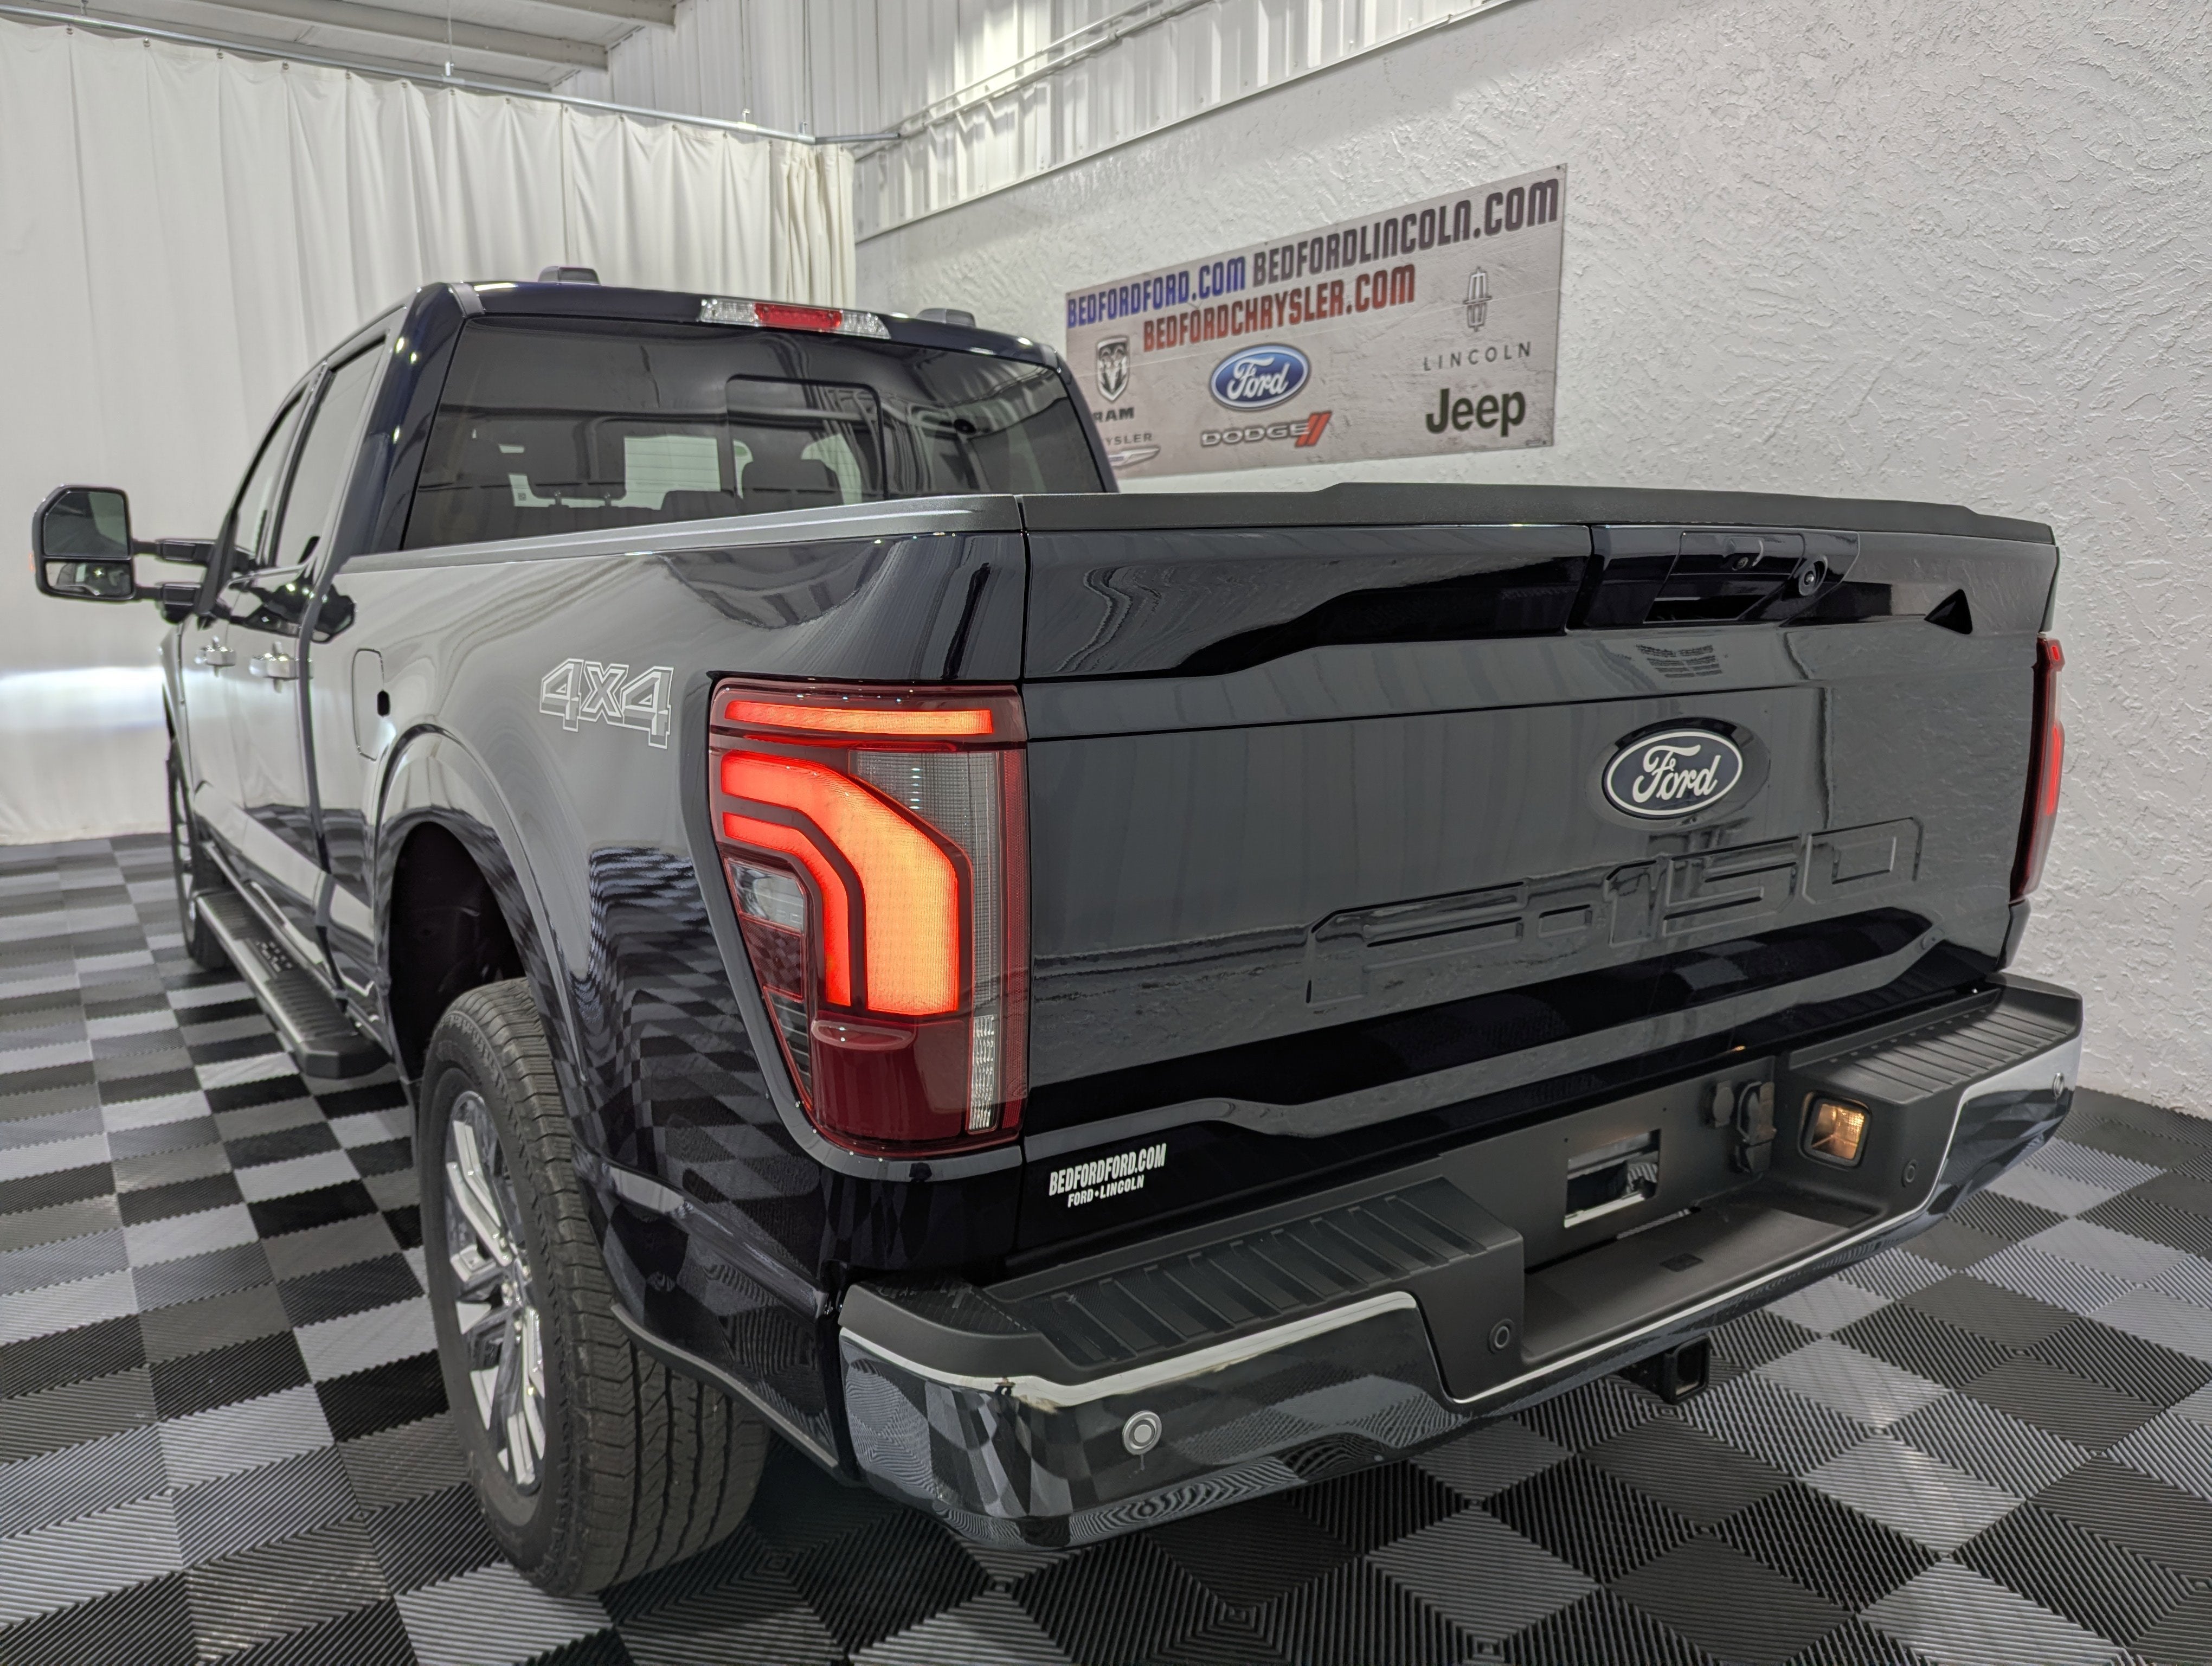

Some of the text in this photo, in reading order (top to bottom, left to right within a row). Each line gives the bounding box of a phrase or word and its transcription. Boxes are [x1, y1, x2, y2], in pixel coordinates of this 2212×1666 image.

[1066, 178, 1559, 329] BEDFORDFORD.COM BEDFORDLINCOLN.COM
[1143, 264, 1416, 353] BEDFORDCHRYSLER.COM
[1226, 356, 1291, 400] Ford
[1423, 341, 1531, 371] LINCOLN
[1092, 407, 1135, 423] RAM
[1200, 420, 1311, 447] DODGE
[1425, 388, 1526, 437] Jeep
[1104, 433, 1153, 446] YSLER
[539, 658, 674, 749] 4X4
[1632, 744, 1722, 803] Ford
[1049, 1142, 1167, 1196] BEDFORDFORD.COM
